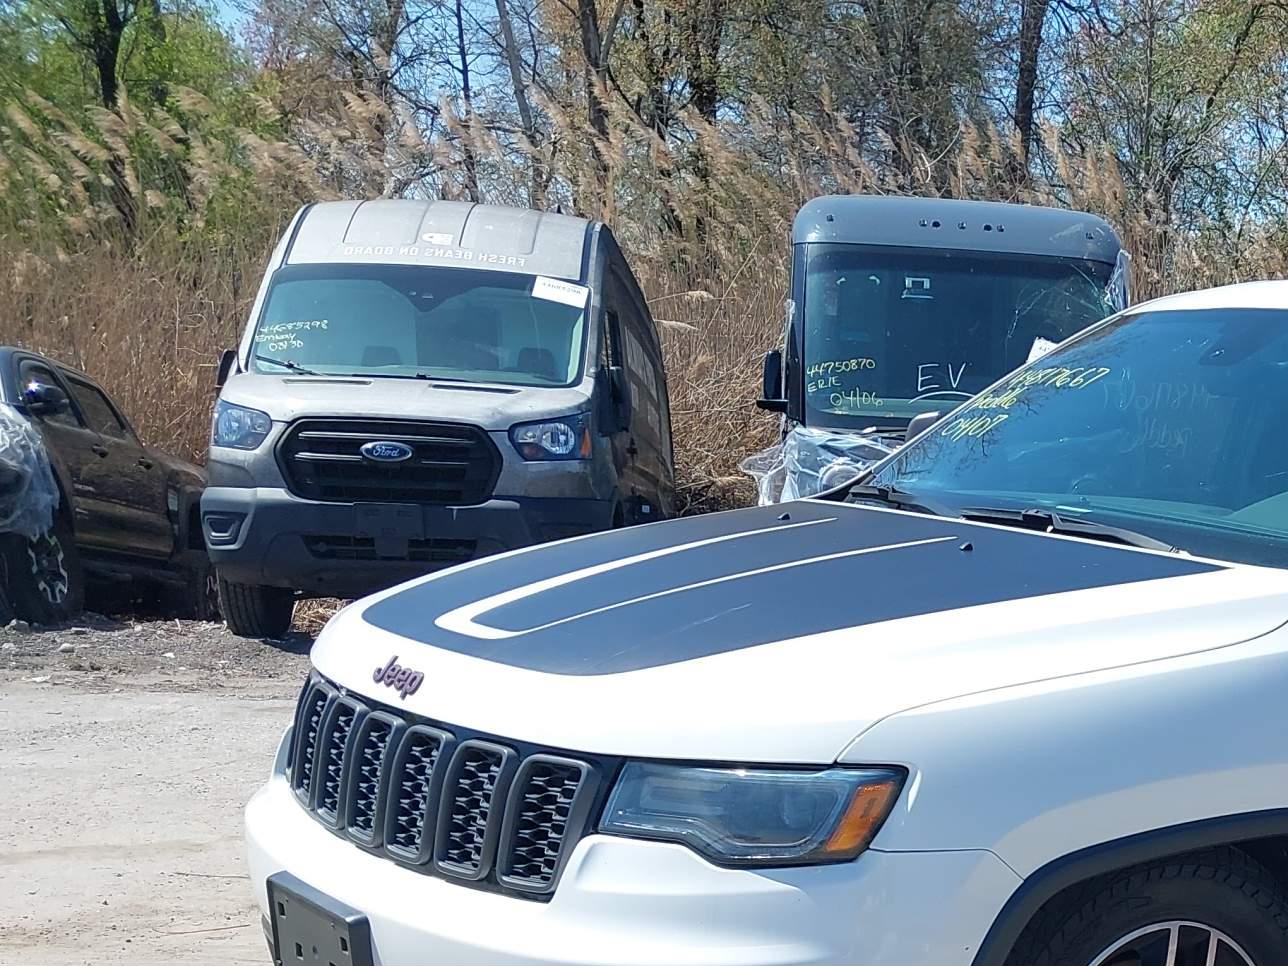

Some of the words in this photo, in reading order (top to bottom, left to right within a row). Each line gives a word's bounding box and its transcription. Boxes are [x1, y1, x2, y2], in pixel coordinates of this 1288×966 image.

[806, 358, 876, 378] 44750870
[807, 376, 842, 393] ERIE
[372, 444, 401, 457] Ford
[372, 655, 425, 700] Jeep
